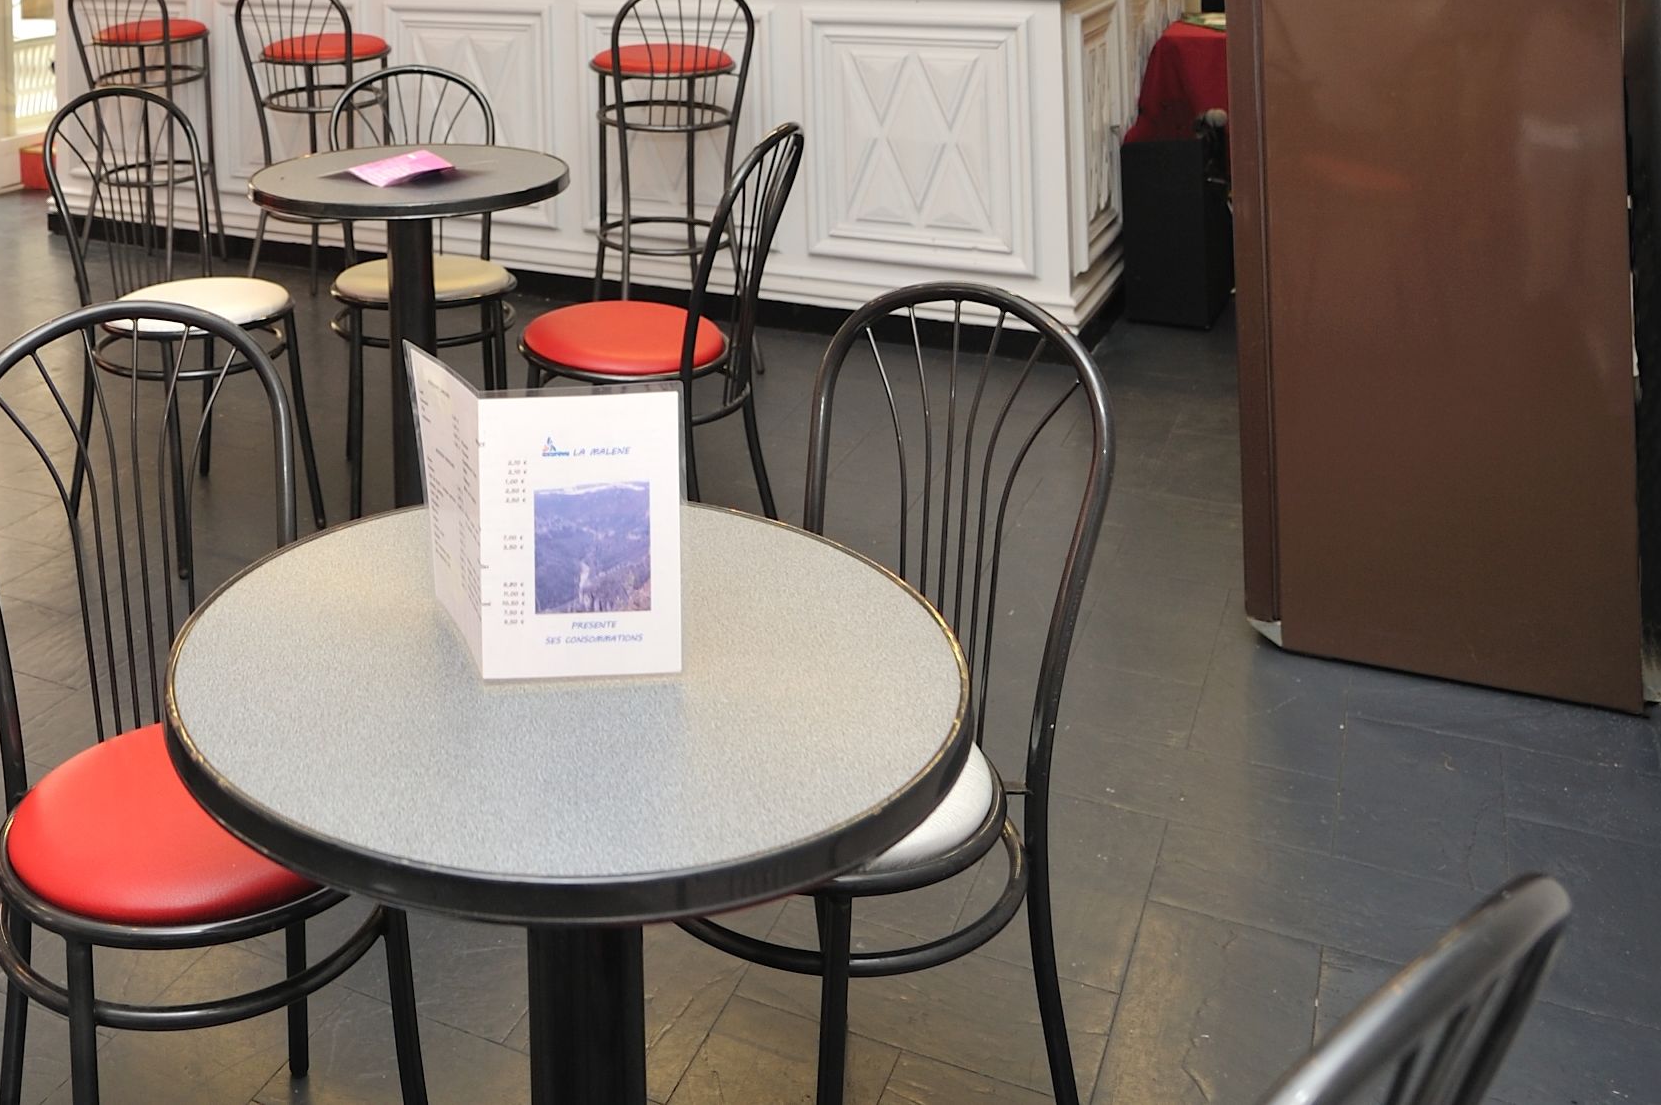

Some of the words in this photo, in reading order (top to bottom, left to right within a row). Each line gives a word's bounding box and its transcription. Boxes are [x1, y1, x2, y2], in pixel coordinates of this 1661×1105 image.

[573, 448, 585, 457] LA
[590, 446, 631, 456] MALENE
[572, 621, 617, 629] PRESENTE
[545, 636, 561, 645] SES
[565, 633, 643, 644] CONSOMMATIONS
